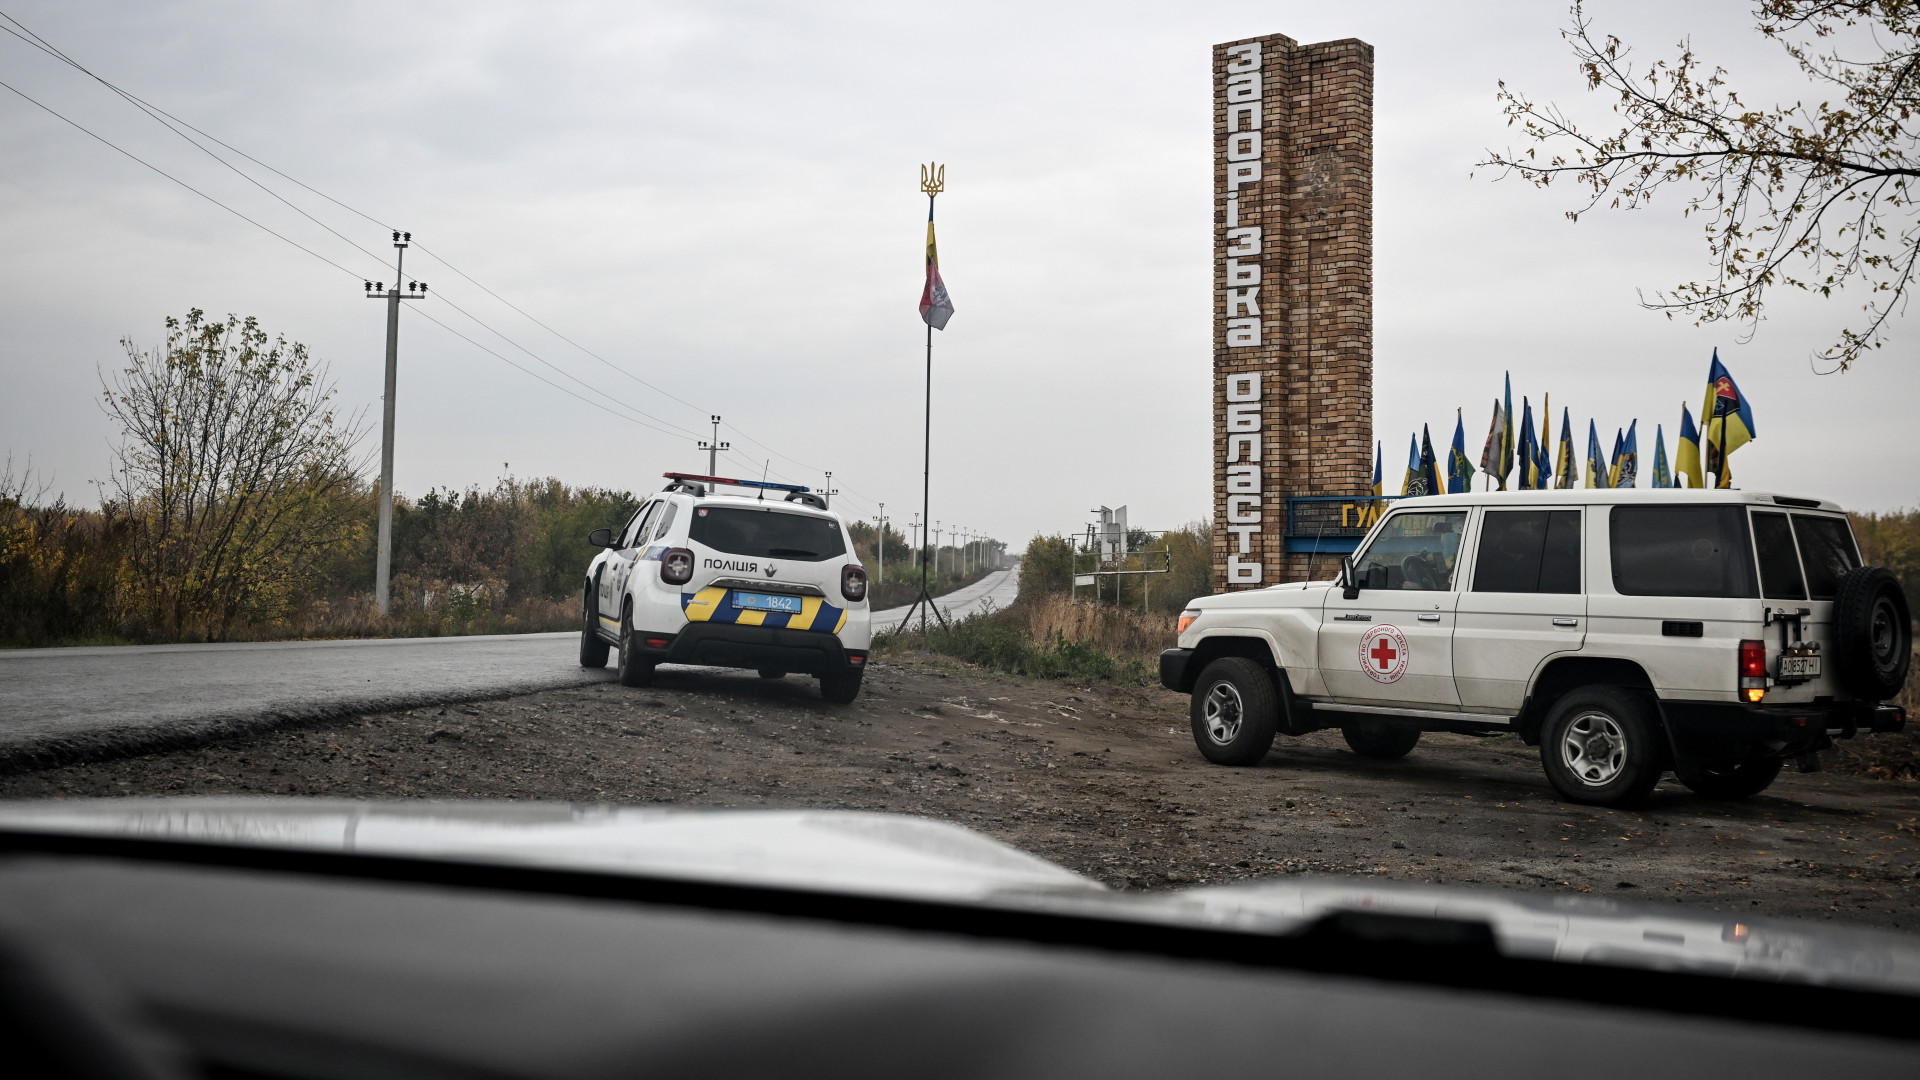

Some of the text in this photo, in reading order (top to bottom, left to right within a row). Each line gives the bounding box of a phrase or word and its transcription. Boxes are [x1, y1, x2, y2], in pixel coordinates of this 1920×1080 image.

[1342, 504, 1389, 528] ГУЛ
[704, 558, 758, 573] ПОЛІЦІЯ
[766, 596, 792, 610] 1842
